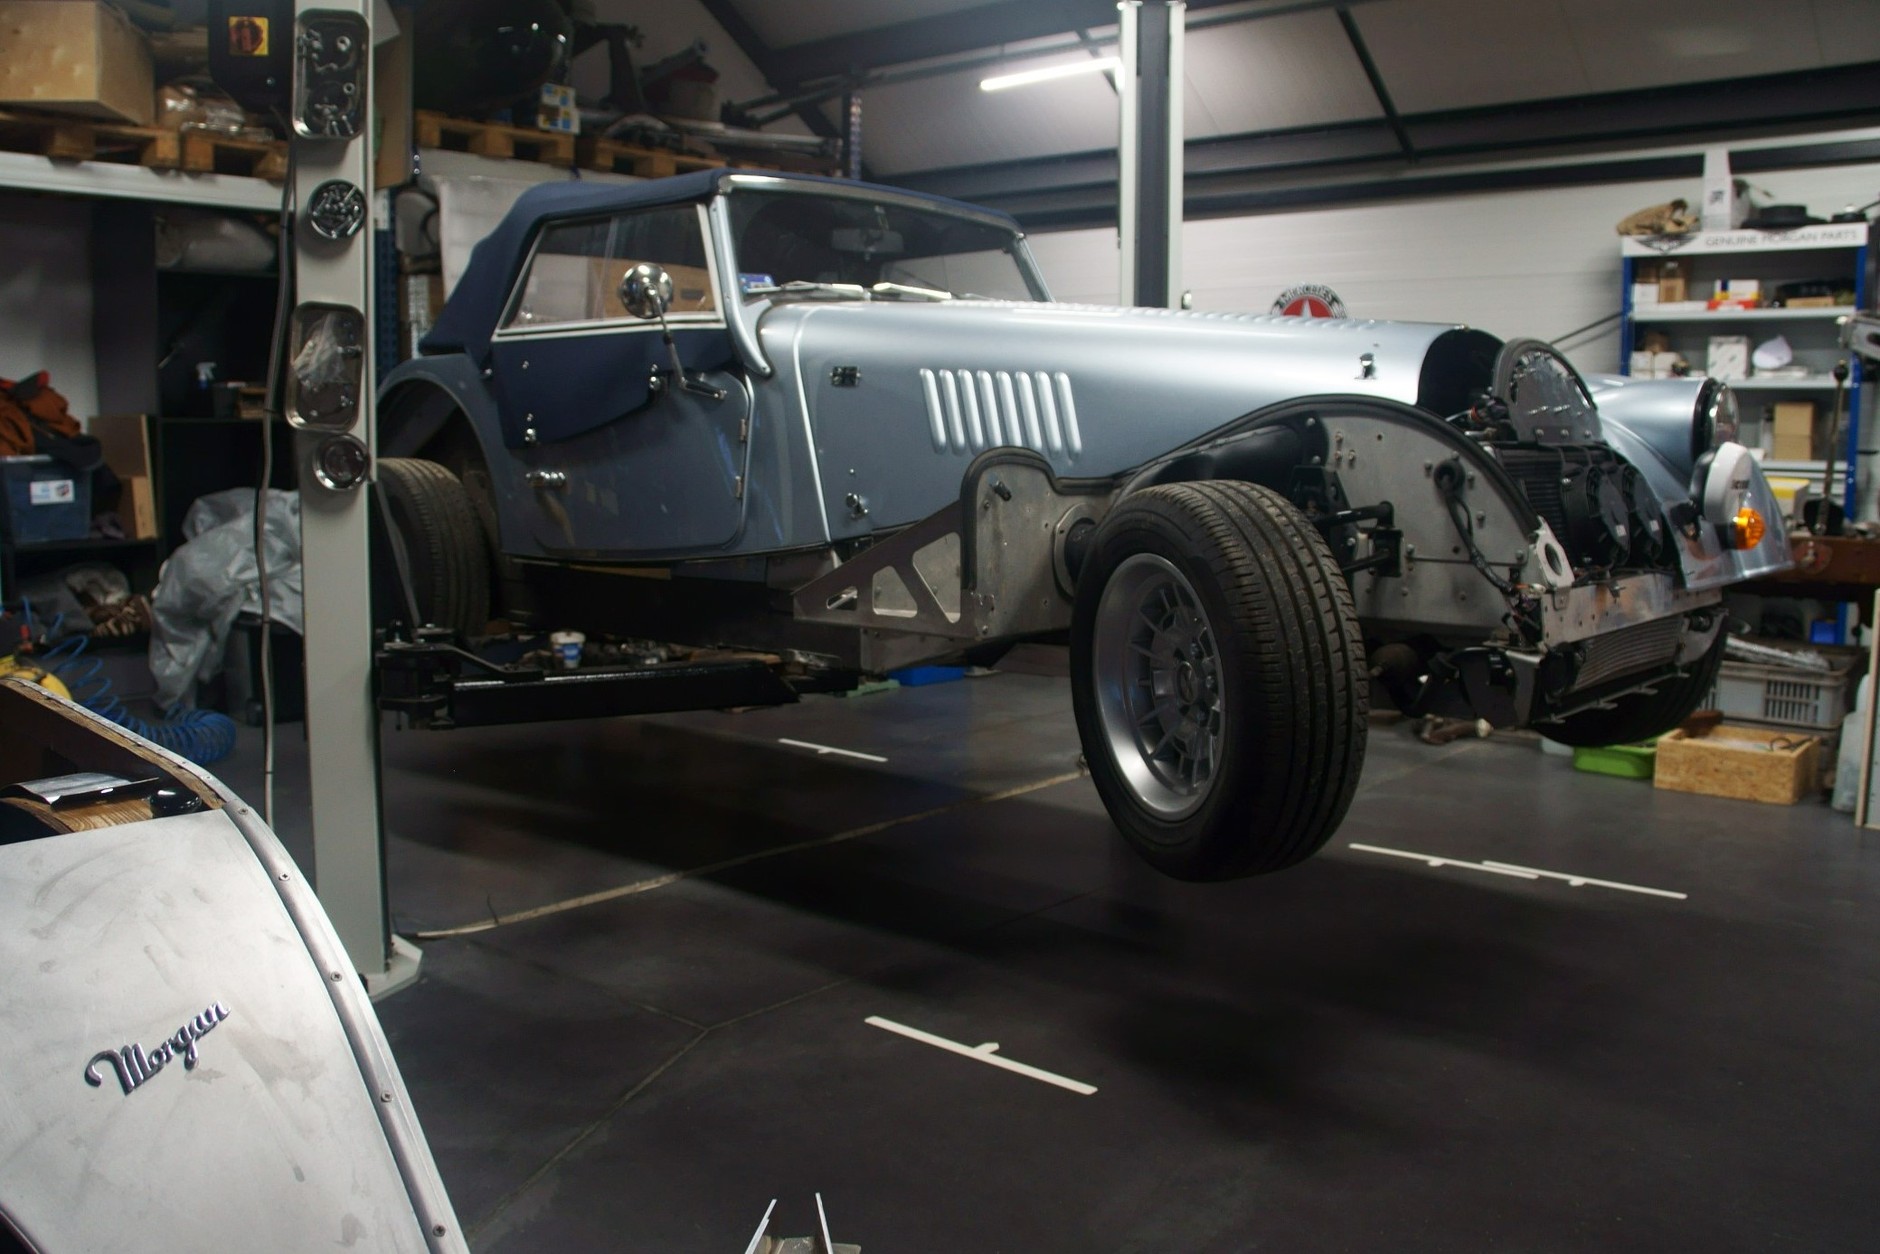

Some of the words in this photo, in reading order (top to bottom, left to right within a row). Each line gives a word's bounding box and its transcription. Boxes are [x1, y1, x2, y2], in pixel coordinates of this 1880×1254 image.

[1706, 234, 1757, 246] GENUINE
[1820, 228, 1857, 240] PARTS
[1279, 284, 1333, 304] MERCEDES
[84, 1000, 231, 1095] Morgan
